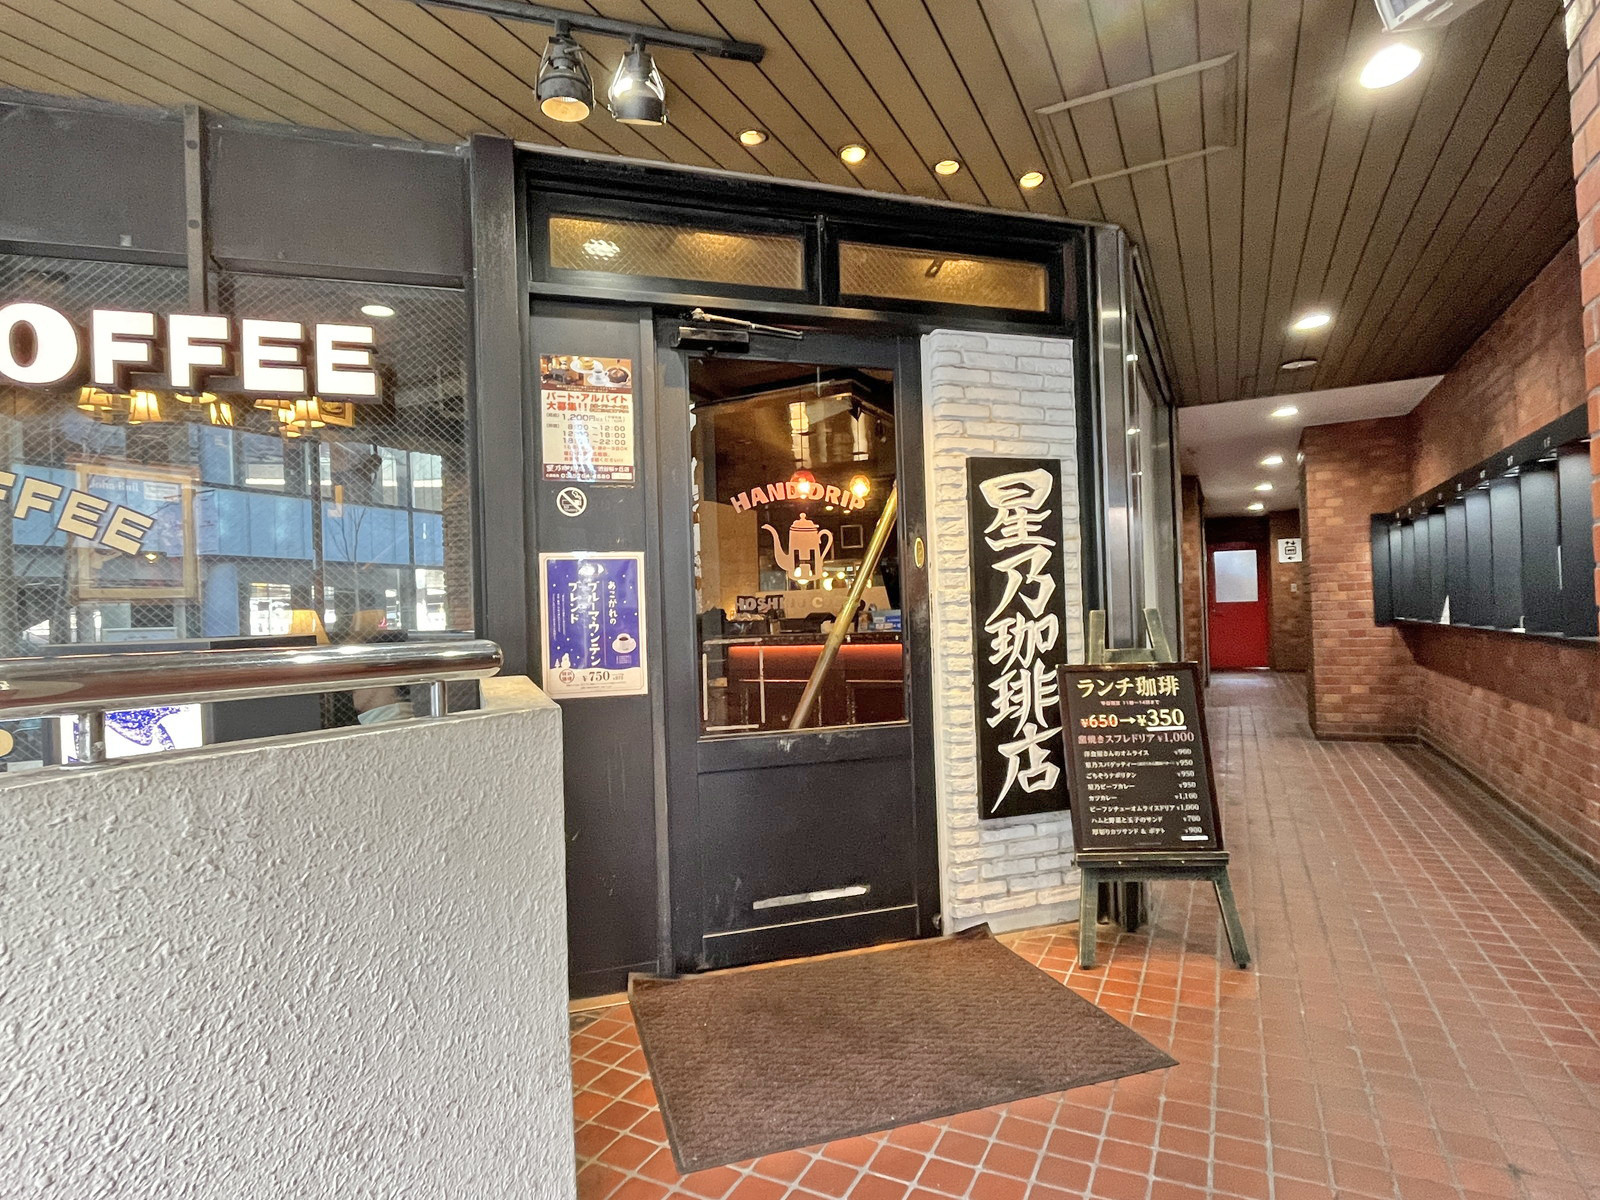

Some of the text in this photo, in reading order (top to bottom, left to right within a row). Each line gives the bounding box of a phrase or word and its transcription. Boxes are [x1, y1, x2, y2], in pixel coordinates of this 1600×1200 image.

[0, 302, 378, 397] OFFEE
[546, 392, 628, 403] パート・アルバイト
[730, 482, 866, 513] HAND DRIP
[568, 580, 580, 625] ブレンド
[607, 580, 618, 625] あこがれの
[587, 581, 601, 667] ブルーマウンテン
[978, 468, 1063, 814] 星乃珈琲店
[582, 670, 610, 682] ¥750
[1077, 675, 1180, 698] ランチ珈琲
[1080, 708, 1185, 728] ¥650 ¥350
[1158, 731, 1195, 743] ¥1,000
